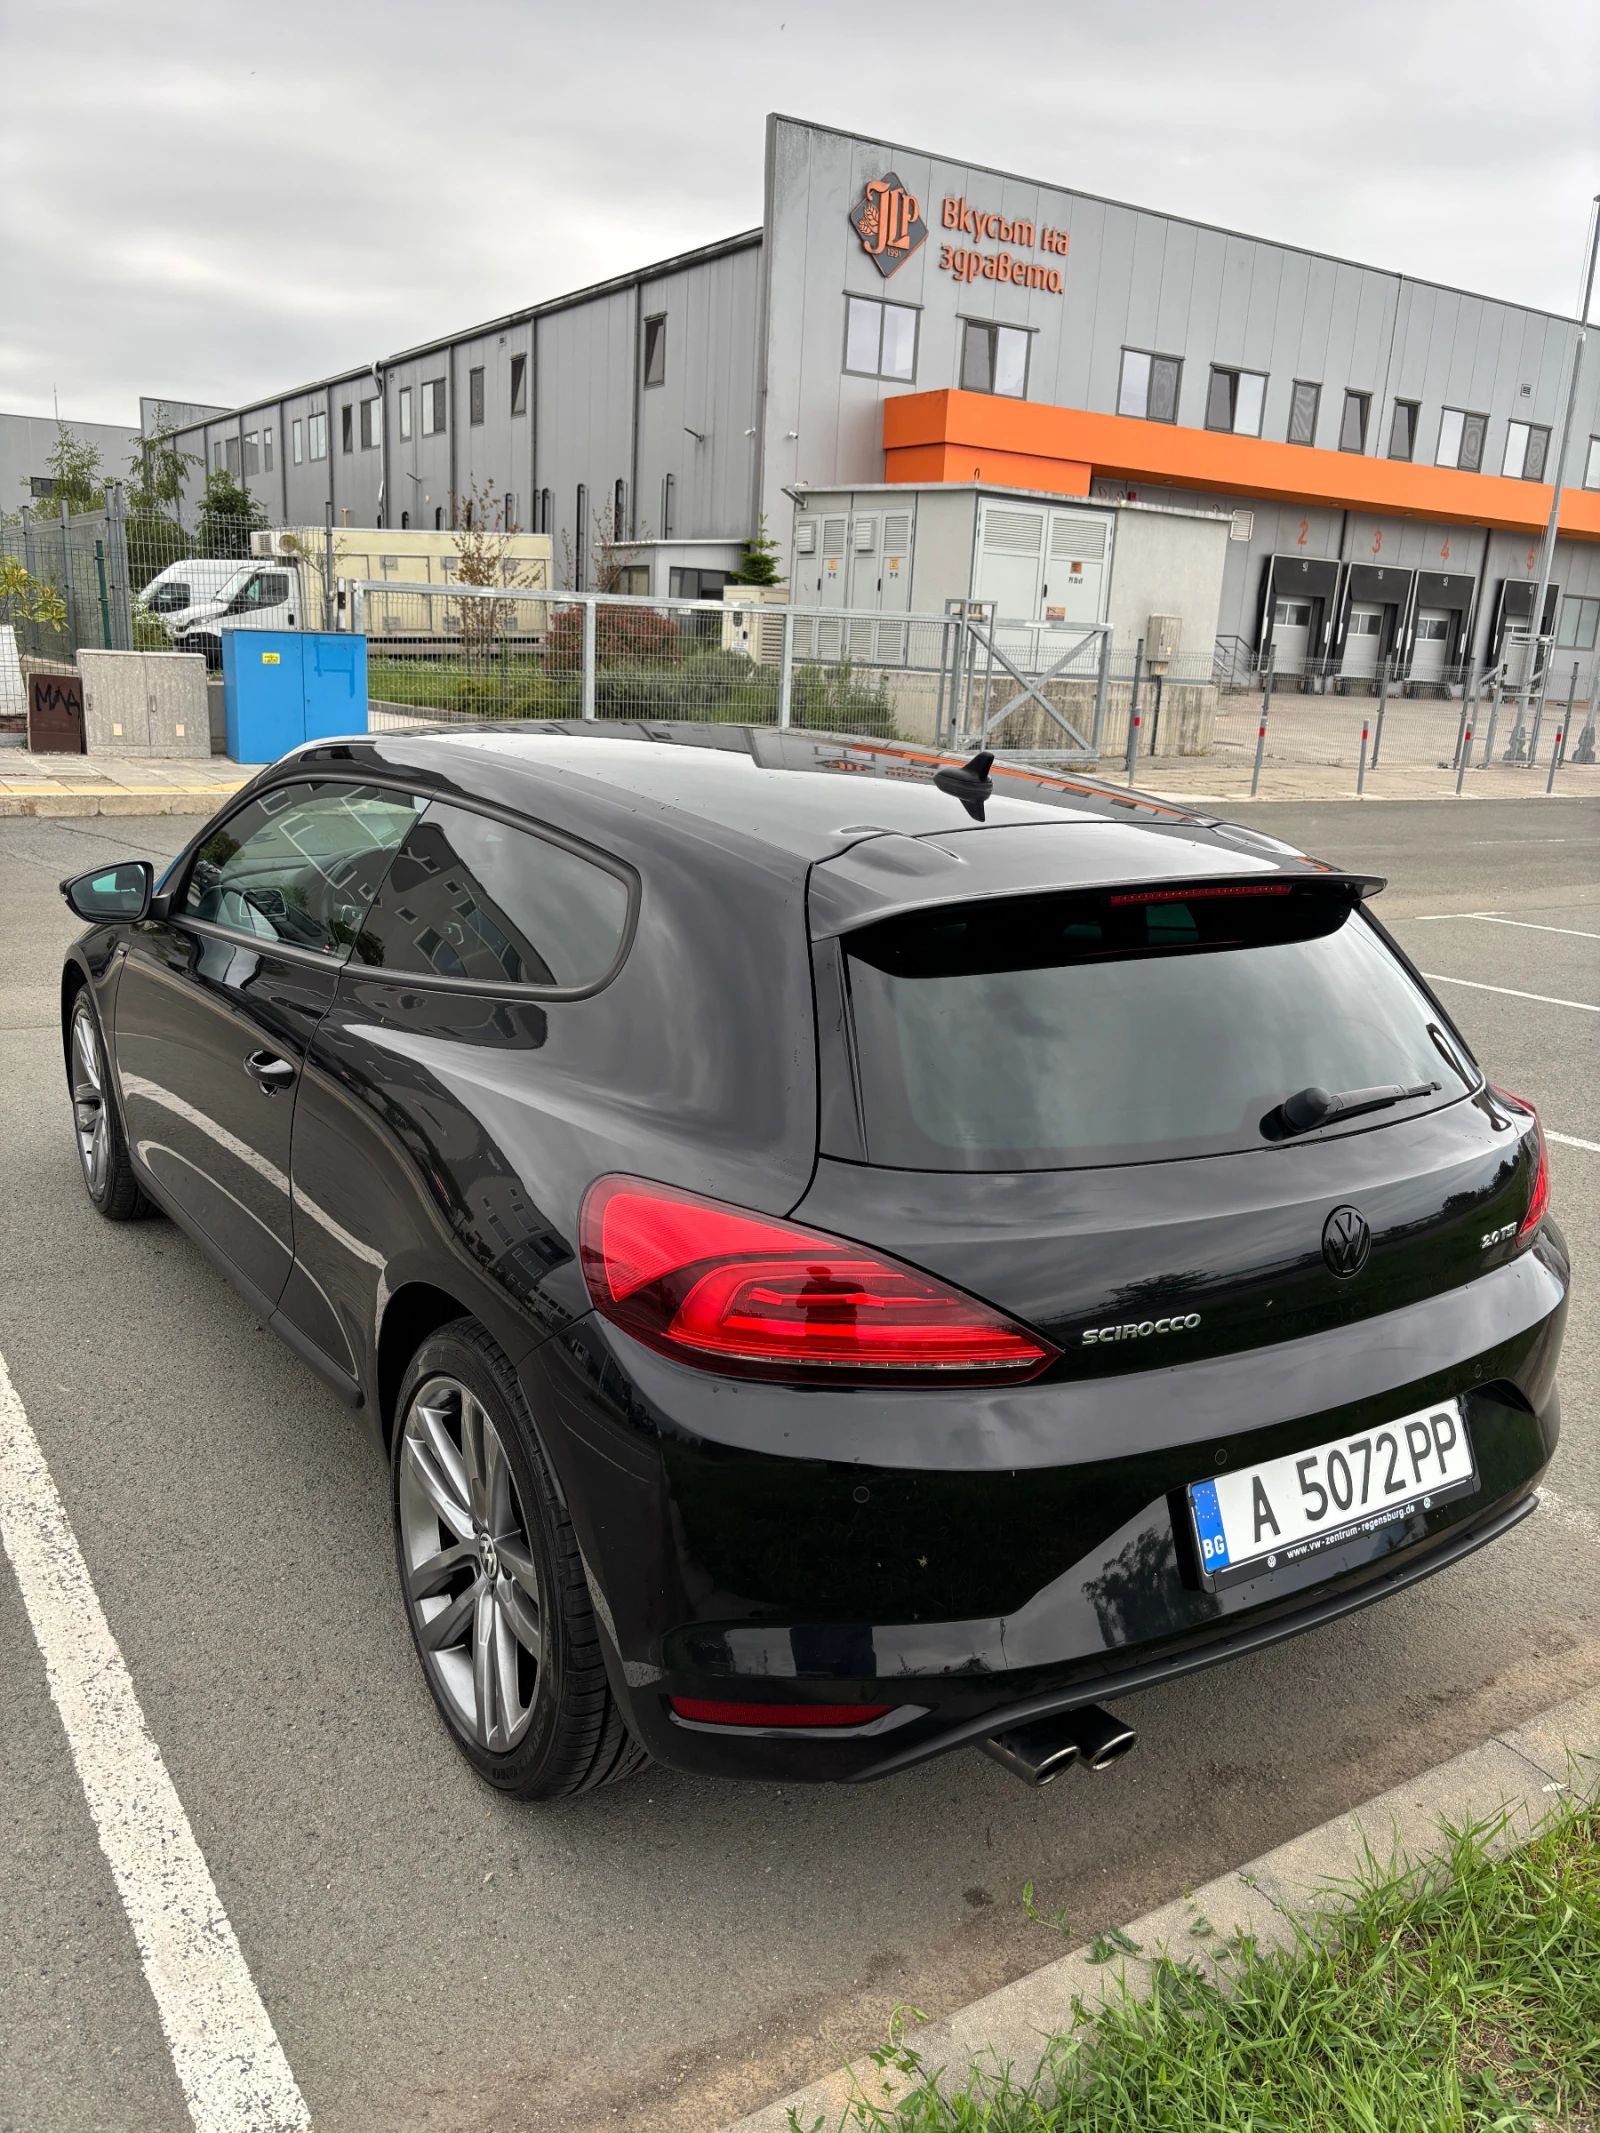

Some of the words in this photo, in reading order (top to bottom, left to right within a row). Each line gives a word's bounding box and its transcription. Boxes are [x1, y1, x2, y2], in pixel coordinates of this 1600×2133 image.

[942, 197, 1035, 248] Вкусът
[1041, 227, 1070, 255] на
[886, 248, 902, 259] 1991
[939, 245, 1065, 294] здравето.
[1297, 521, 1309, 545] 2
[1371, 530, 1383, 553] 3
[1439, 538, 1450, 561] 4
[1525, 548, 1536, 571] 5
[1081, 1312, 1202, 1346] SCIROCCO
[1251, 1475, 1281, 1543] A
[1202, 1537, 1225, 1559] BG
